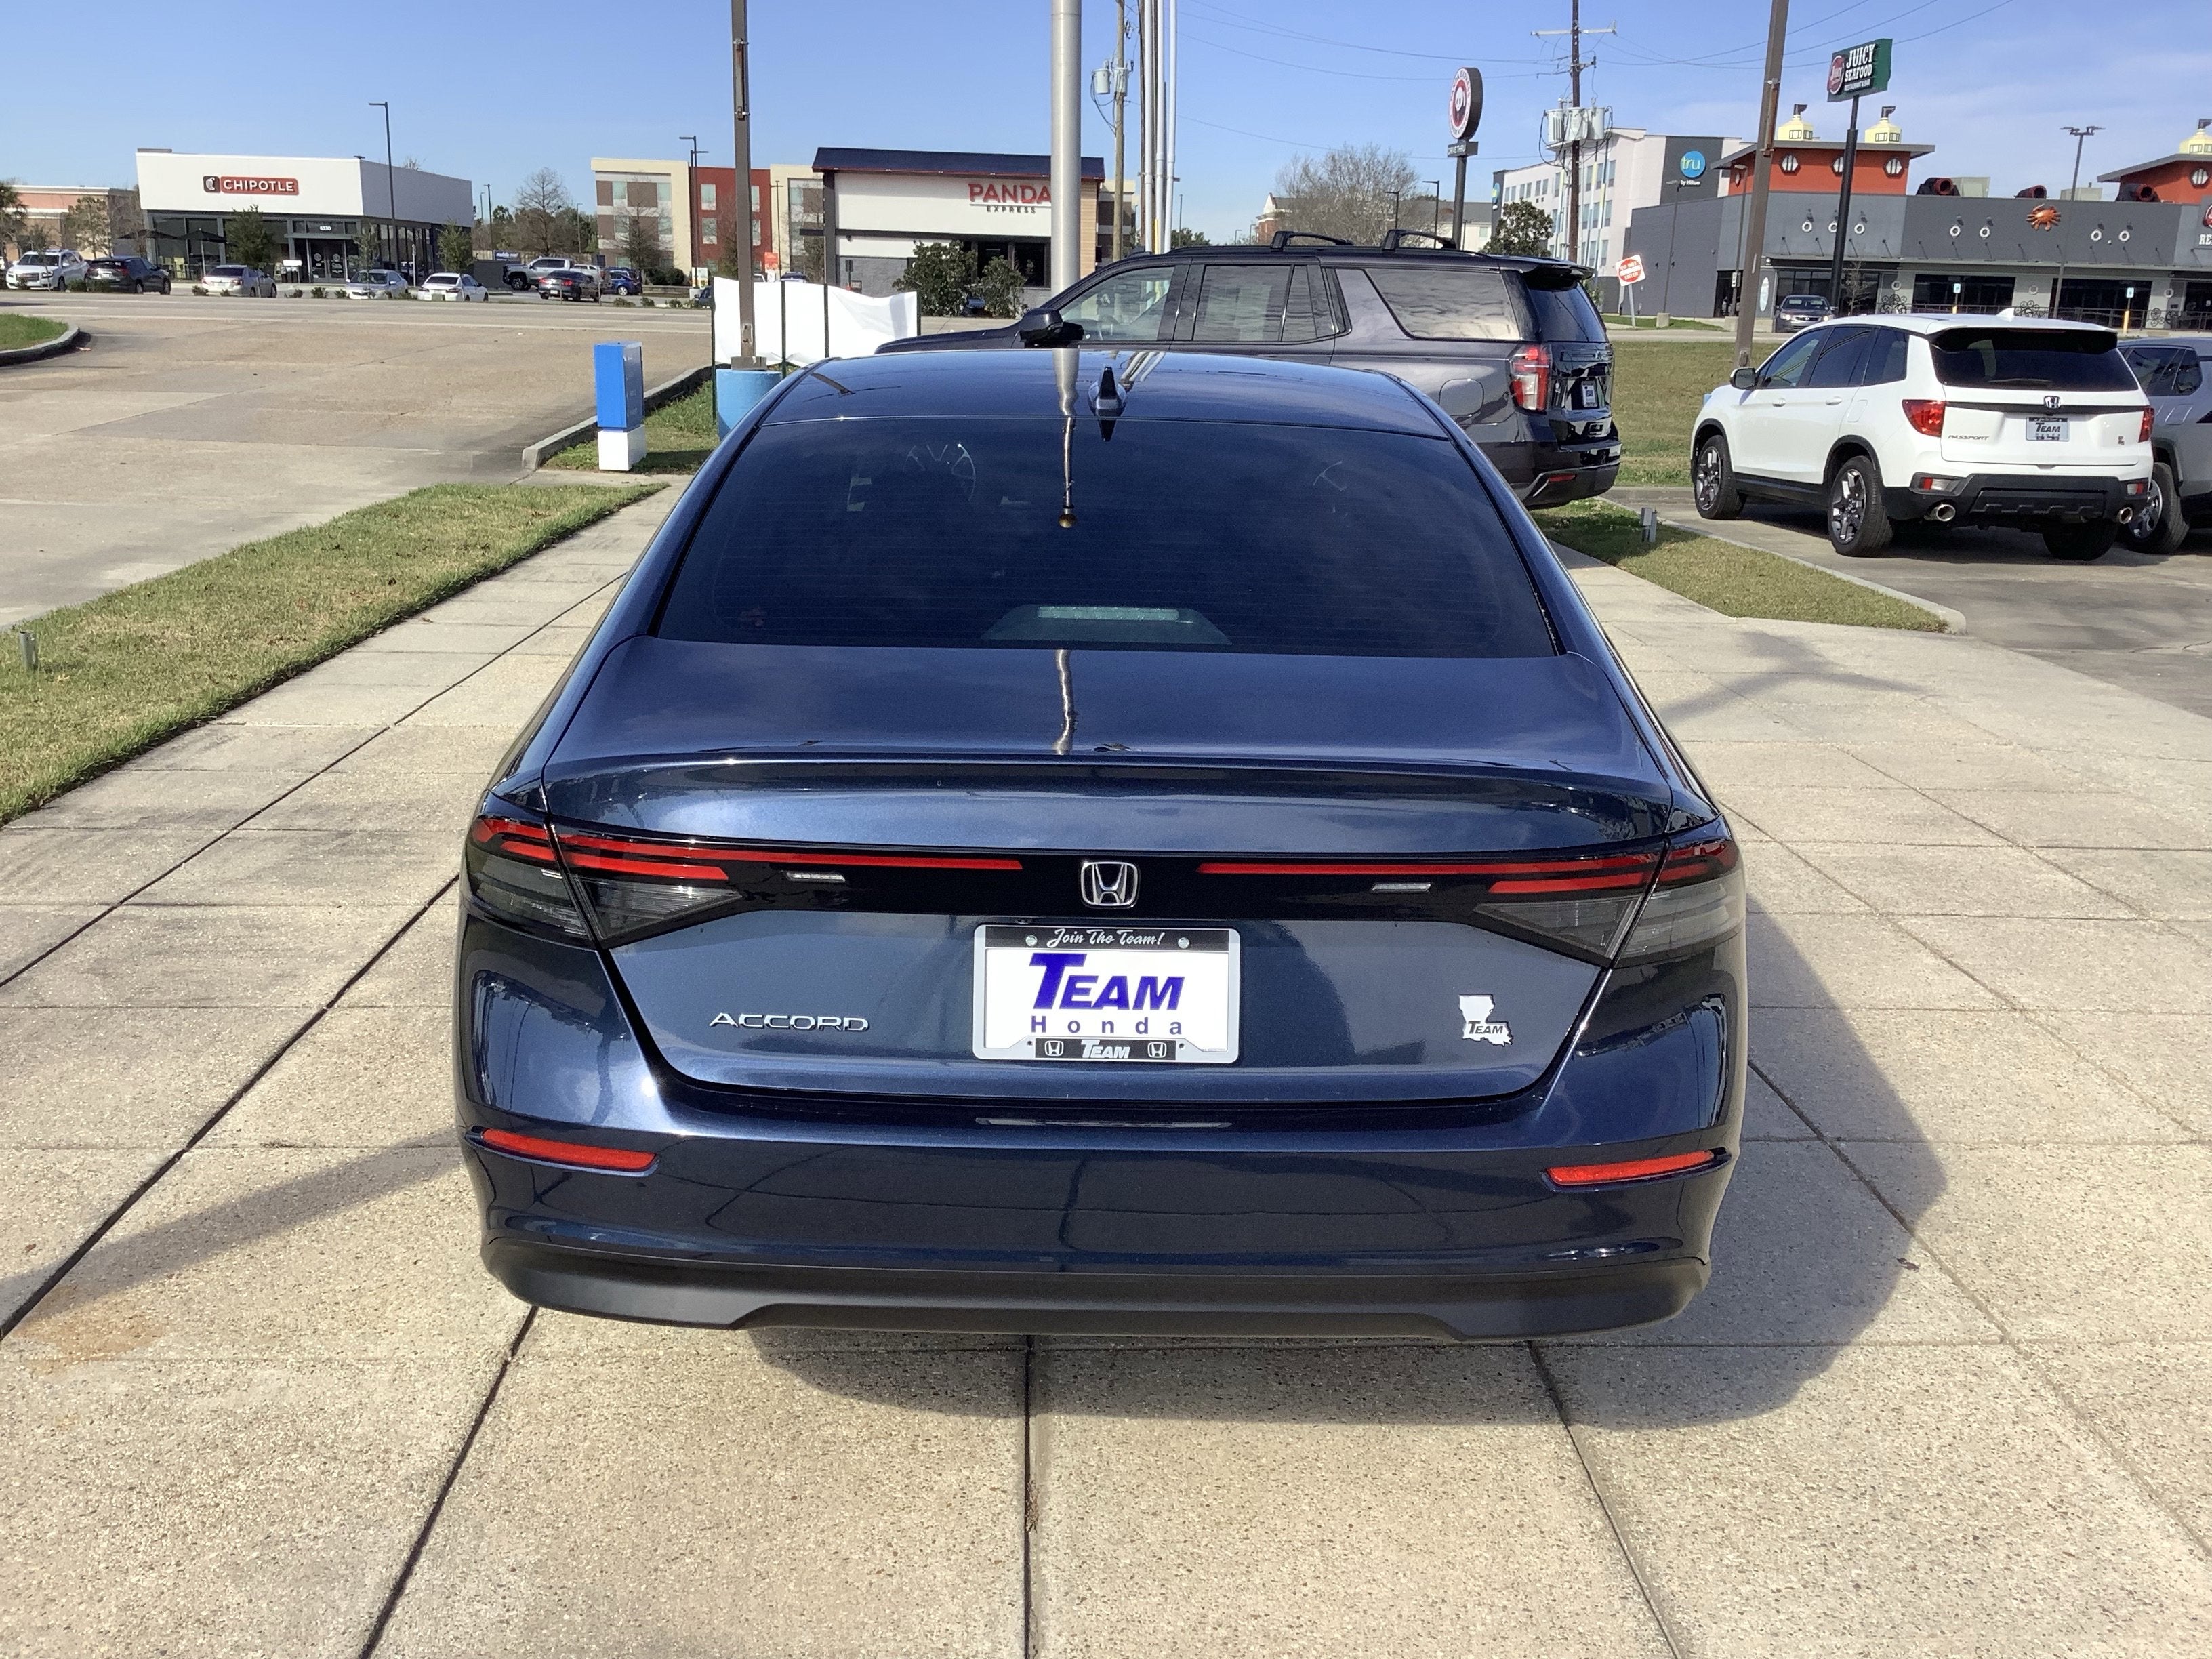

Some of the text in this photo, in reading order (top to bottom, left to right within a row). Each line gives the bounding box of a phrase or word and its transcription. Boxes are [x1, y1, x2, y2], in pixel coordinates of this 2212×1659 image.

[1846, 43, 1876, 68] JUICY
[1845, 64, 1873, 82] SEAFOOD
[1681, 157, 1700, 169] tru
[223, 179, 294, 191] CHIPOTLE
[968, 184, 1051, 204] PANDA
[987, 205, 1036, 213] EXPRESS
[2035, 422, 2061, 432] TEAM
[1046, 928, 1166, 947] Join The Team!
[1029, 952, 1185, 1010] TEAM
[709, 1012, 870, 1031] ACCORD
[1031, 1015, 1183, 1035] Honda
[1468, 1021, 1503, 1034] TEAM
[1081, 1040, 1131, 1059] TEAM
